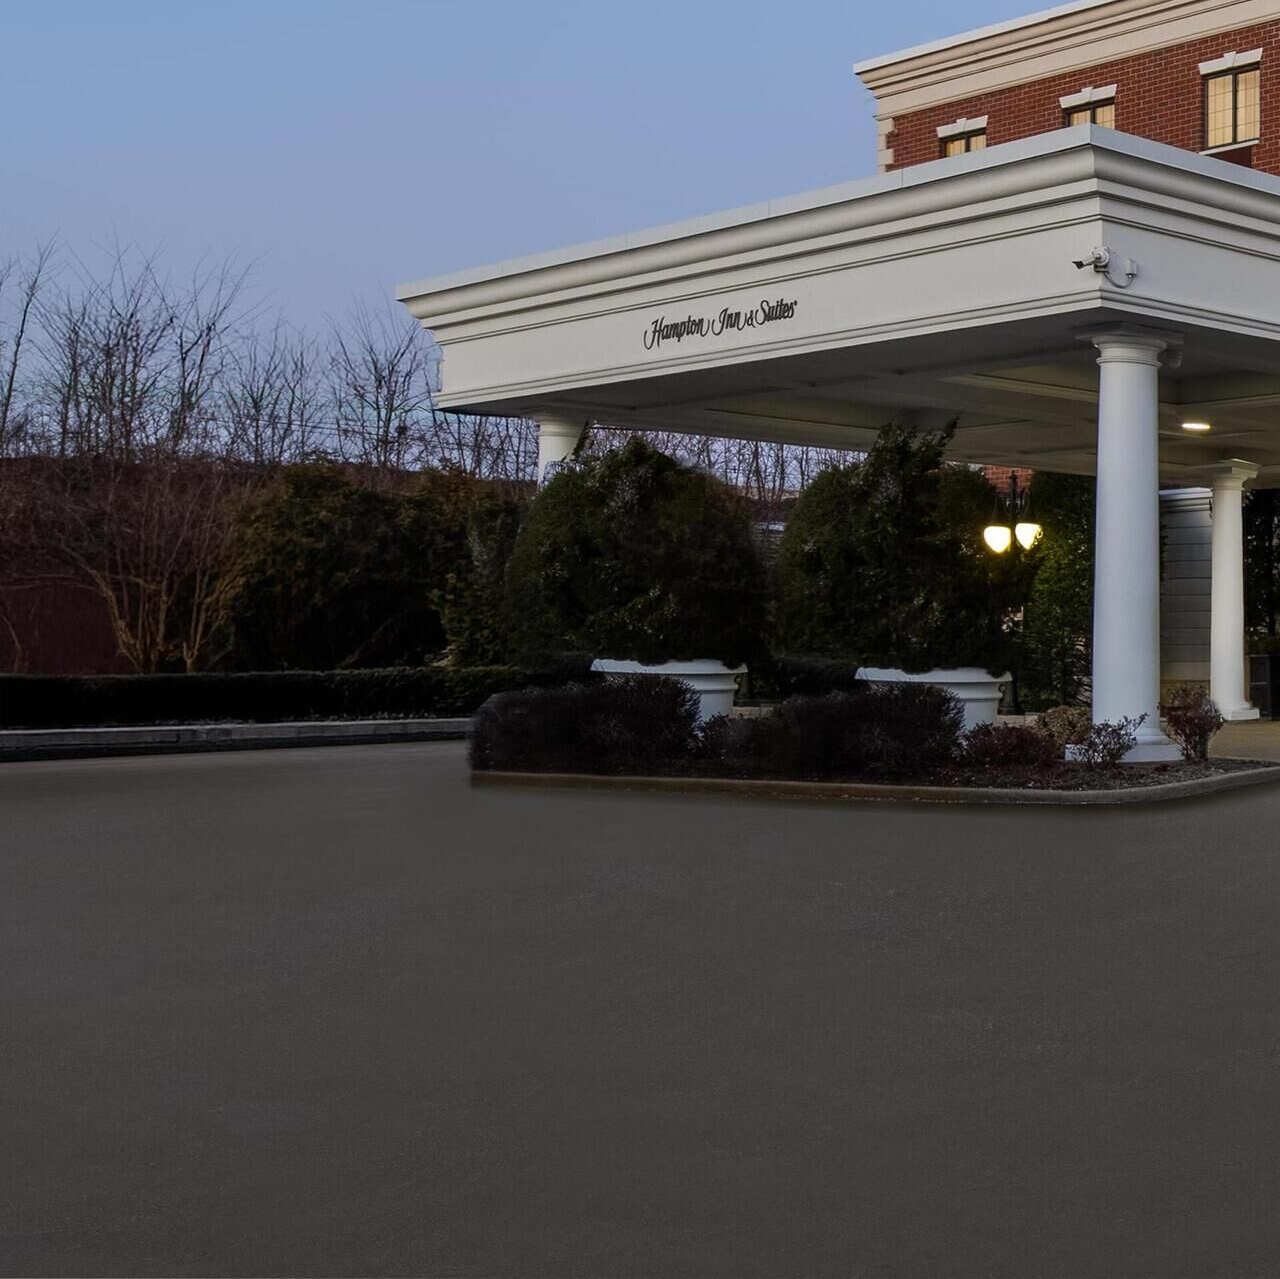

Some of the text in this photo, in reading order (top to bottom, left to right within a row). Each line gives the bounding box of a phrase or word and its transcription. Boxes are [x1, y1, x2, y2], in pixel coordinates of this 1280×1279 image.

[643, 315, 710, 350] Hampton
[711, 307, 747, 336] Inn
[746, 310, 757, 329] &
